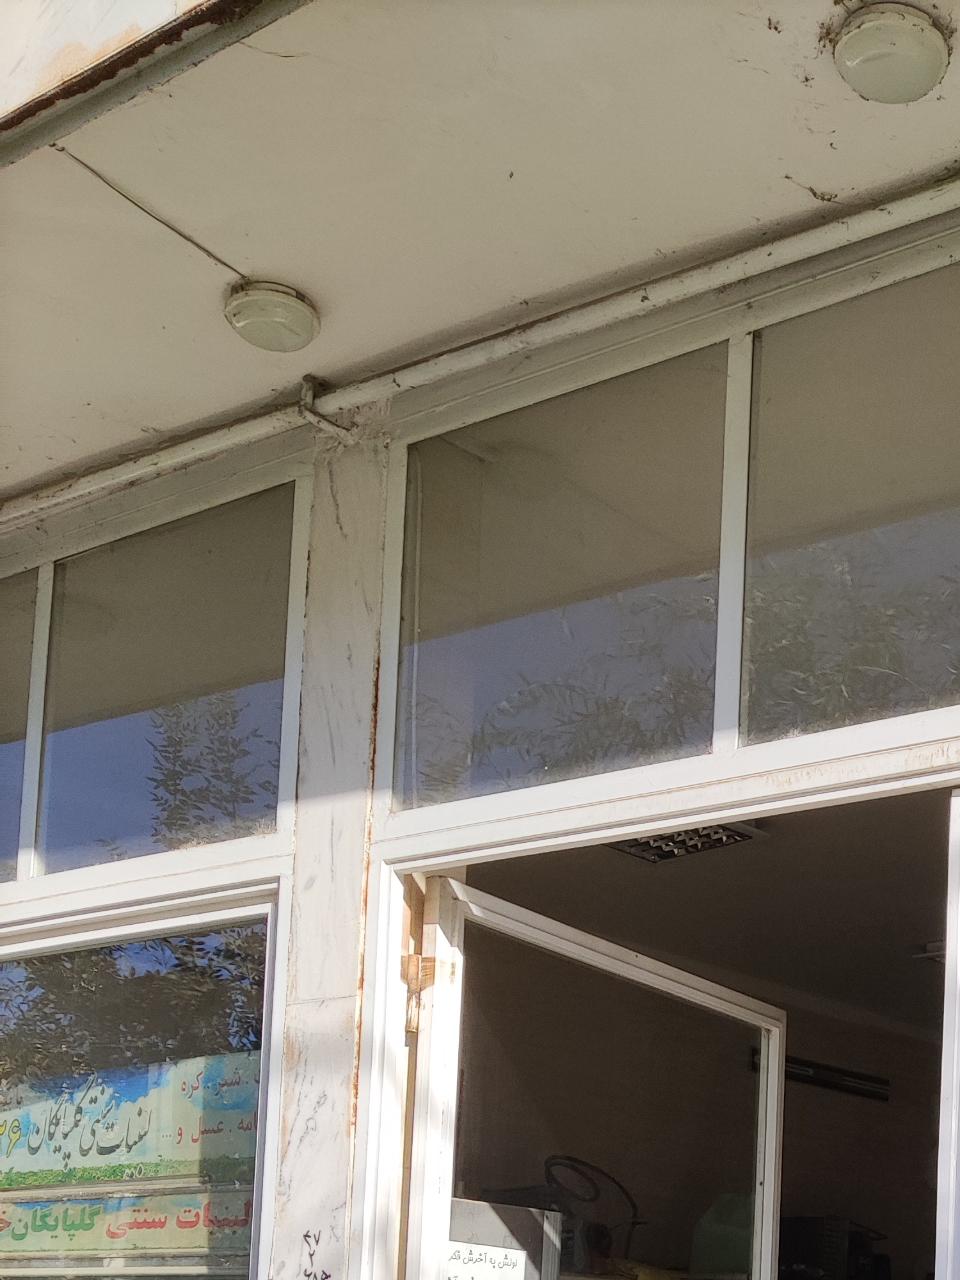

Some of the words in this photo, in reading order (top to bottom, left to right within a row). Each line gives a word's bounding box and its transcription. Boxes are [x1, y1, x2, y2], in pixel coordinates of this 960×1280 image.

[181, 1071, 204, 1099] کره
[10, 1206, 101, 1241] گلپایگان
[105, 1208, 168, 1240] سنتی
[175, 1201, 251, 1236] لبنیات
[463, 1250, 487, 1264] آخرش
